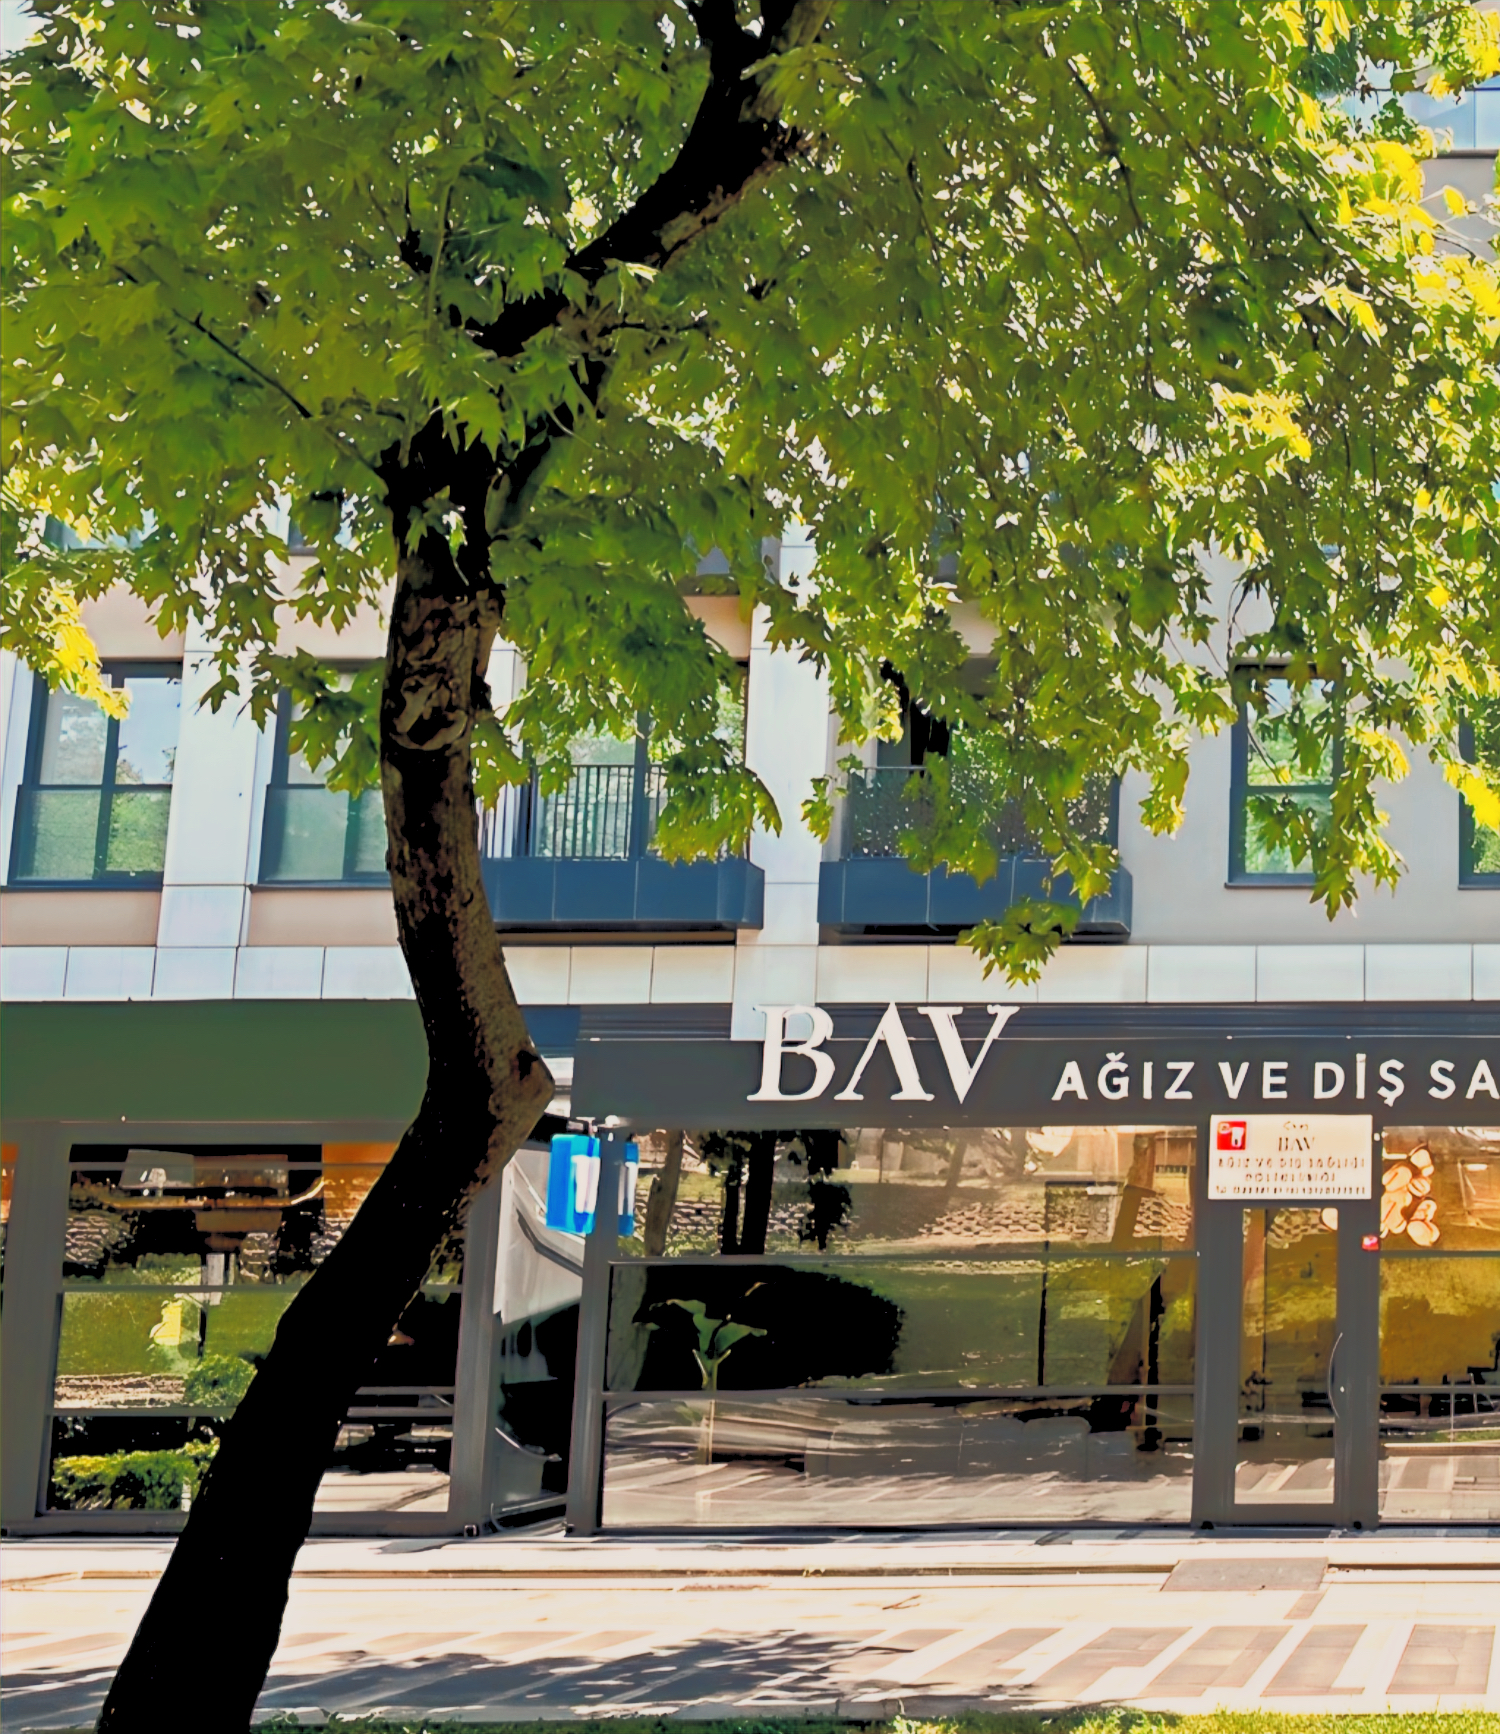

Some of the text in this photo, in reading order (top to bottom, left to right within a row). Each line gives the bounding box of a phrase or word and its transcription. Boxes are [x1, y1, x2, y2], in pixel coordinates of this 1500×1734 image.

[746, 1001, 1020, 1104] BAV
[1052, 1051, 1195, 1100] AĞIZ
[1218, 1061, 1289, 1099] VE
[1313, 1053, 1405, 1107] DİŞ
